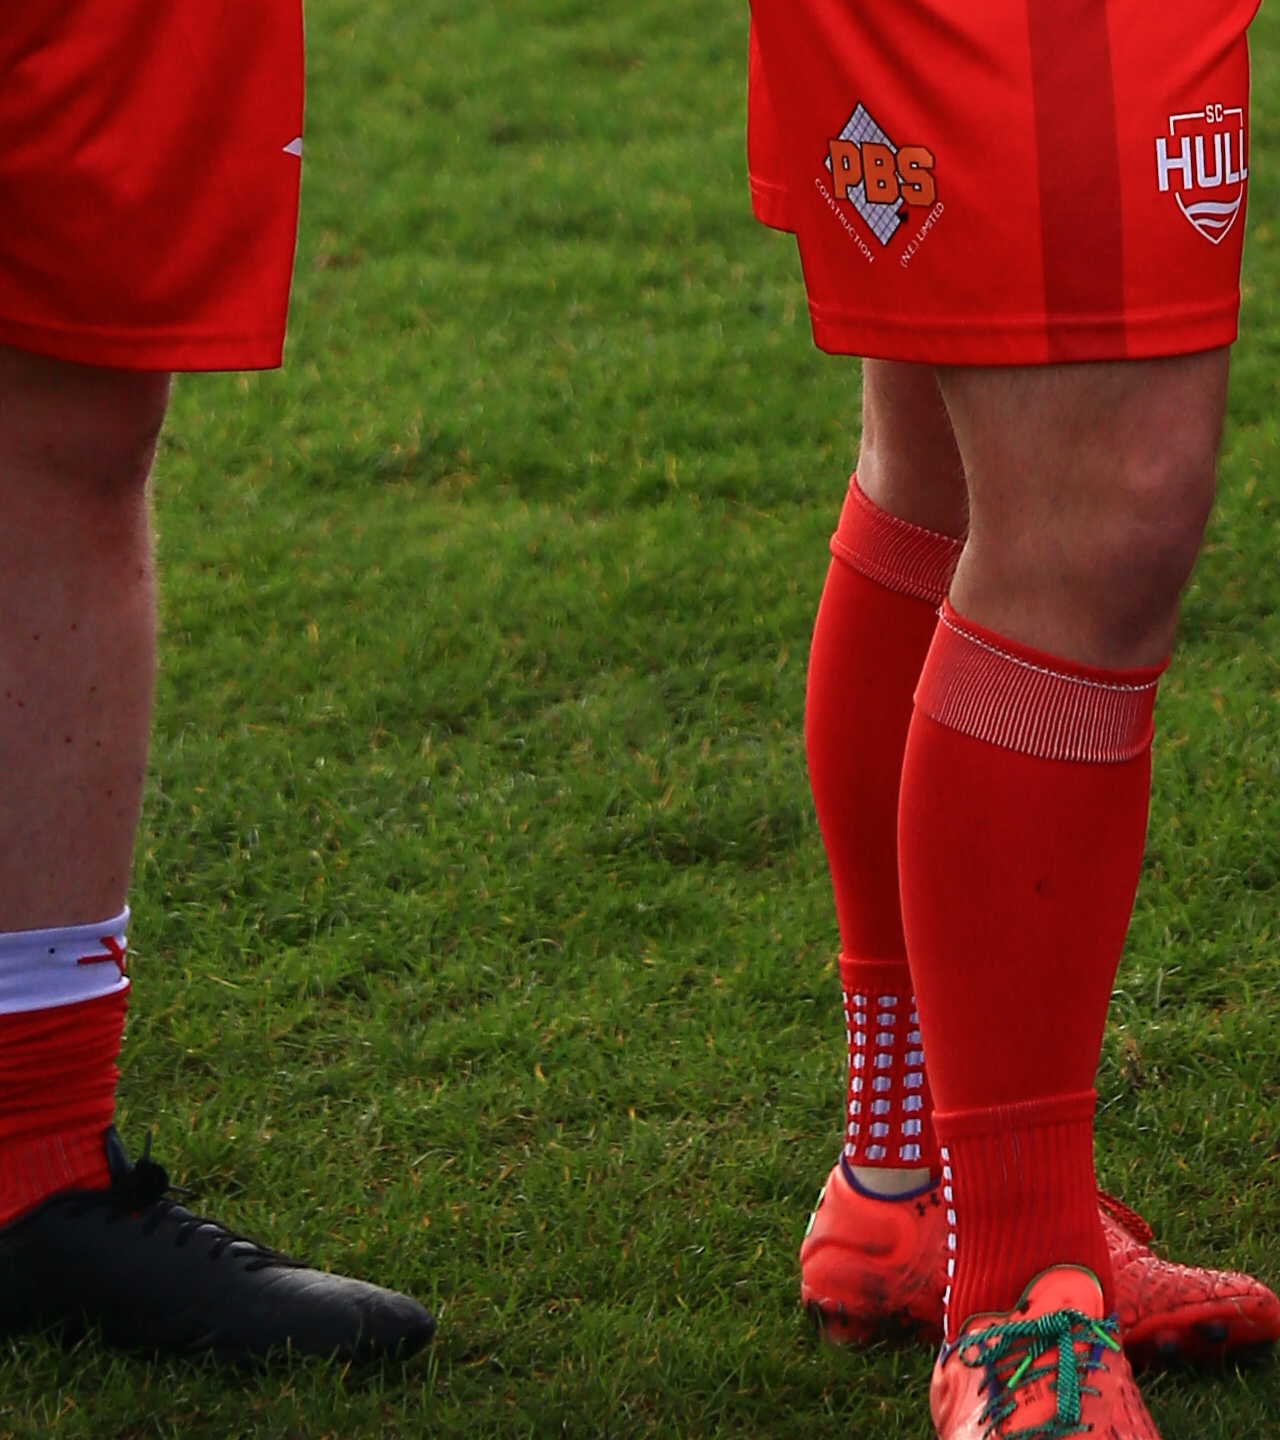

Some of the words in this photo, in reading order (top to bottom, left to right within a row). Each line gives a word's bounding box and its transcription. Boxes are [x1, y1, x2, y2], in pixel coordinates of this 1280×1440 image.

[1205, 104, 1223, 123] SC
[828, 138, 937, 207] PBS
[1155, 128, 1249, 192] HULL
[814, 178, 875, 263] CONSTRUCTION
[916, 201, 946, 243] LIMITED
